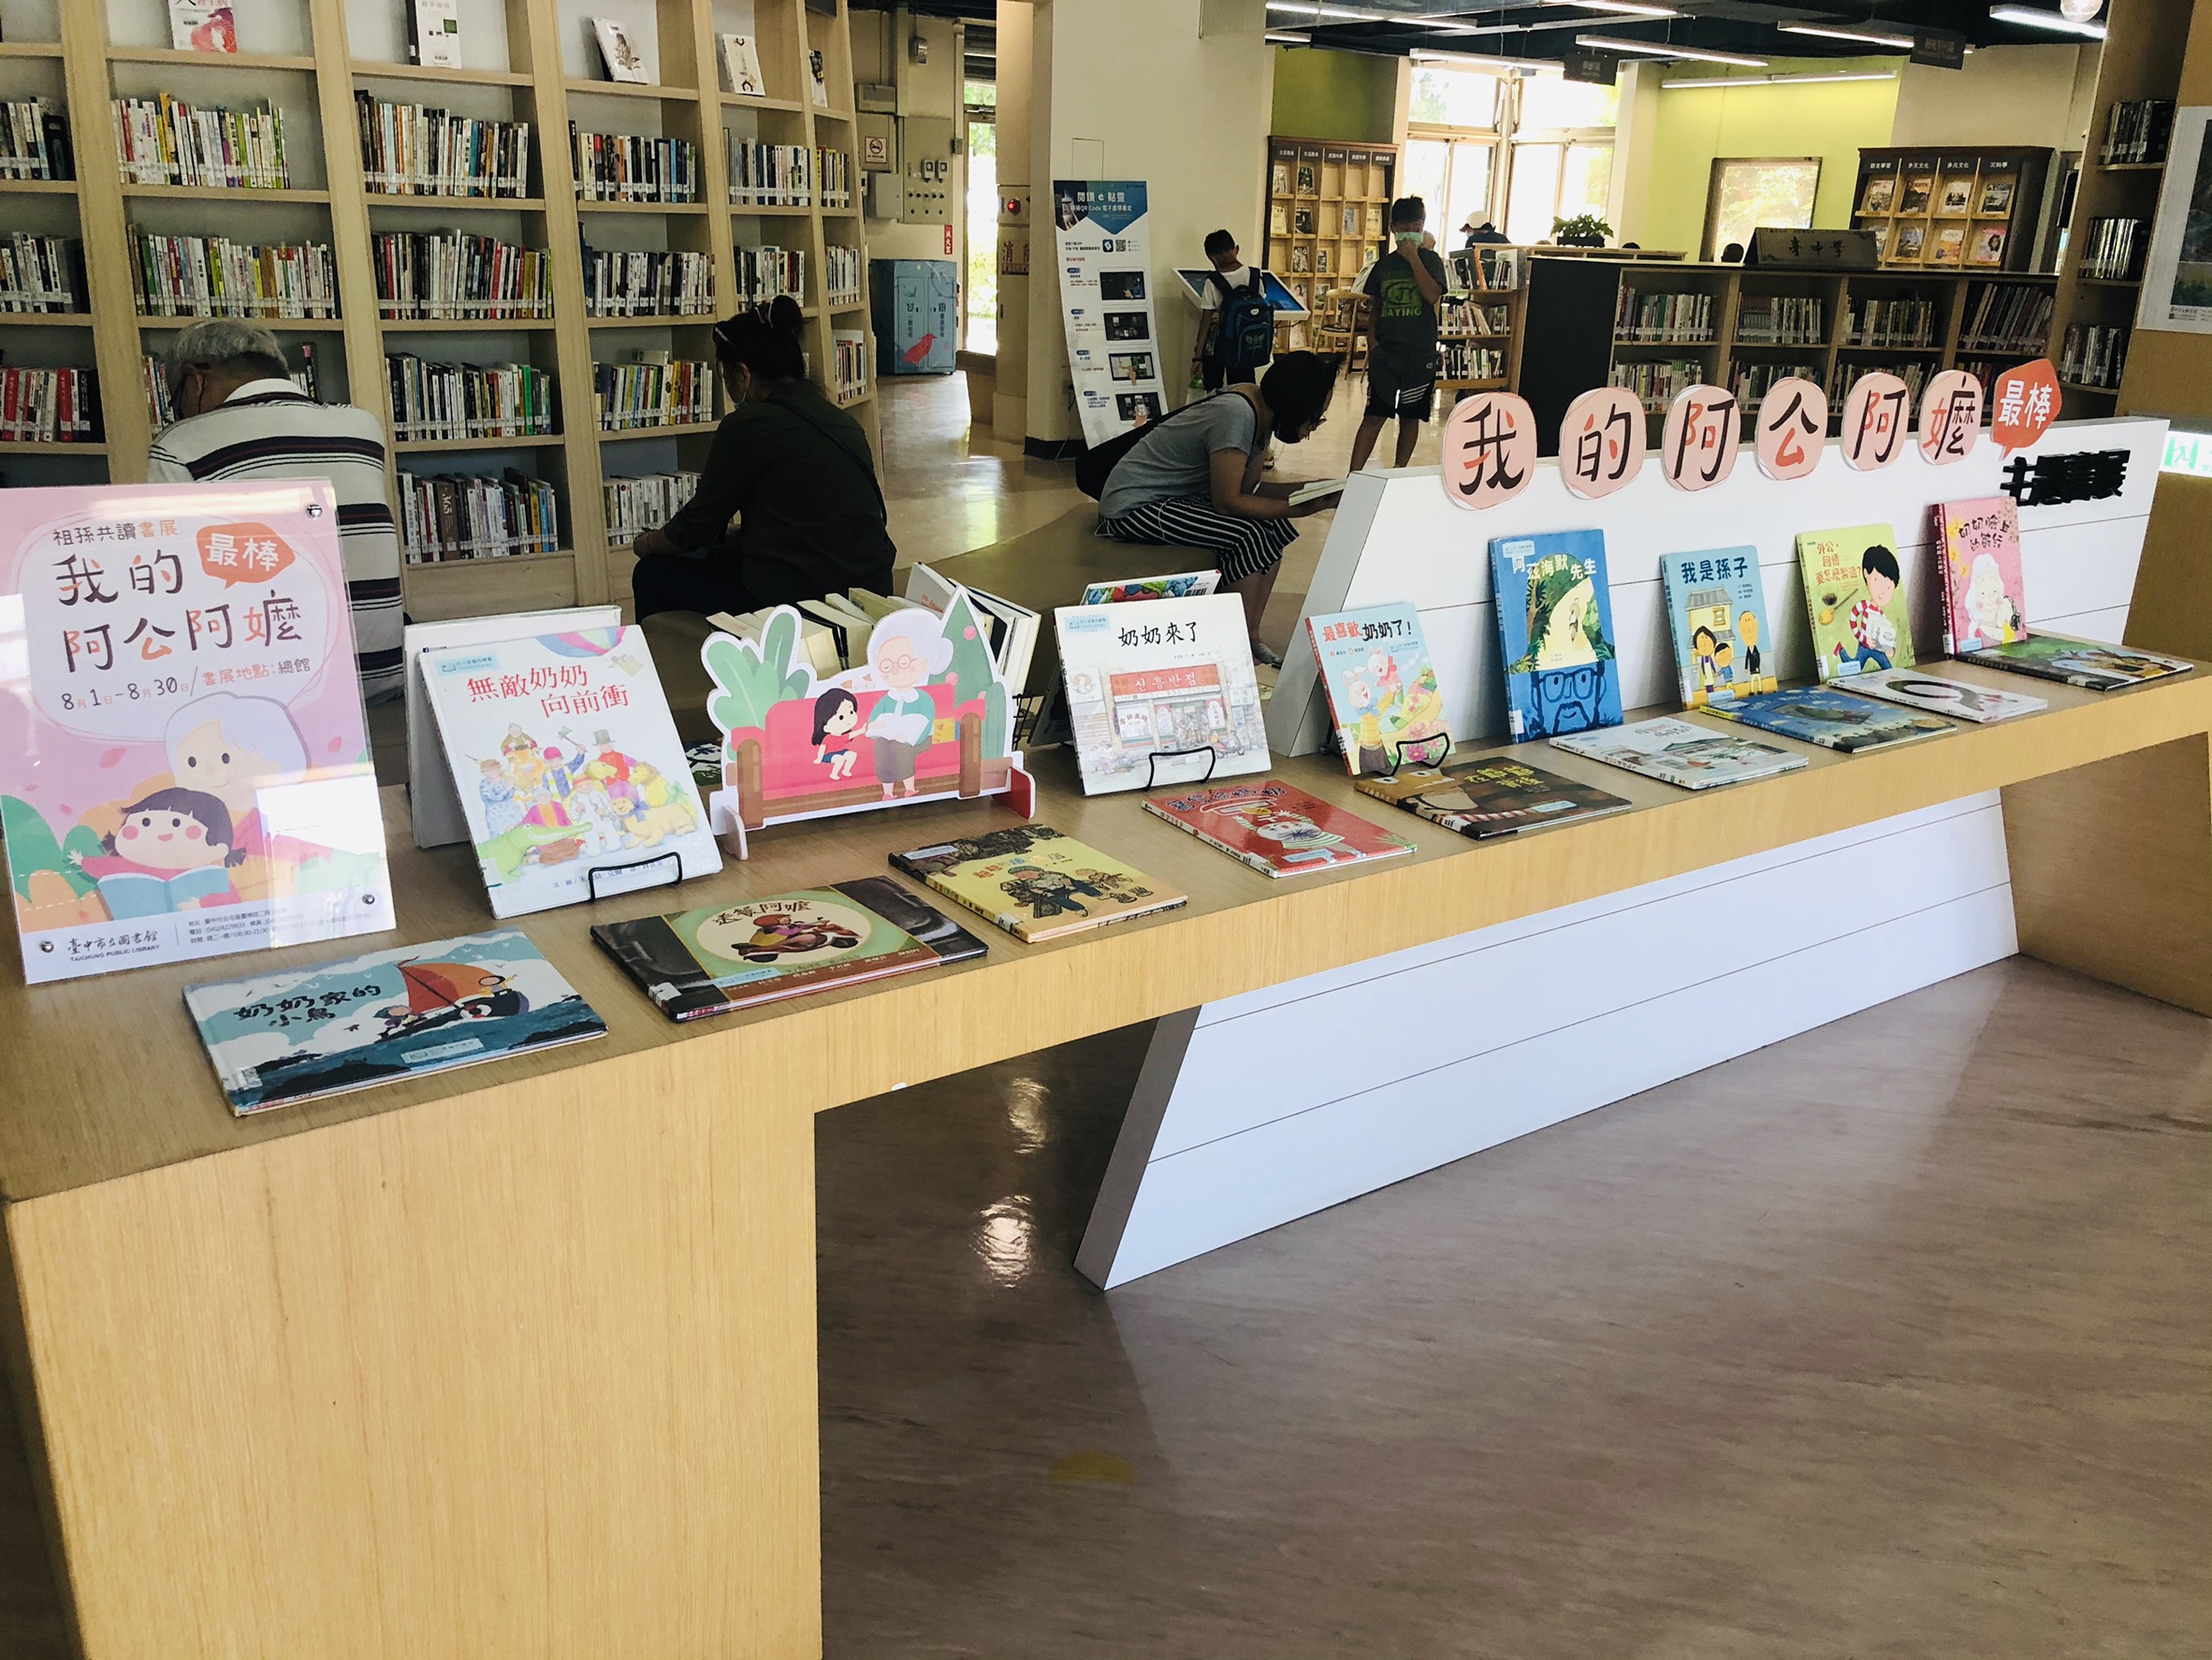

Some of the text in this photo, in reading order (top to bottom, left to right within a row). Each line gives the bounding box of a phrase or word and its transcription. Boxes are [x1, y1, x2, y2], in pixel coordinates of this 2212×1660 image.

[1998, 380, 2053, 430] 最棒
[52, 520, 179, 546] 祖孫共讀書展
[51, 532, 280, 605] 我的 最棒
[1681, 557, 1748, 584] 我是孫子
[63, 589, 302, 673] 阿公阿嬤
[1117, 621, 1198, 648] 奶奶來了
[466, 664, 589, 703] 無敵奶奶
[540, 684, 629, 719] 向前衝
[67, 930, 159, 955] 臺中市立圖書館
[70, 943, 160, 963] TAICHUNG PUBLIC LIBRARY
[233, 984, 381, 1021] 奶奶家的
